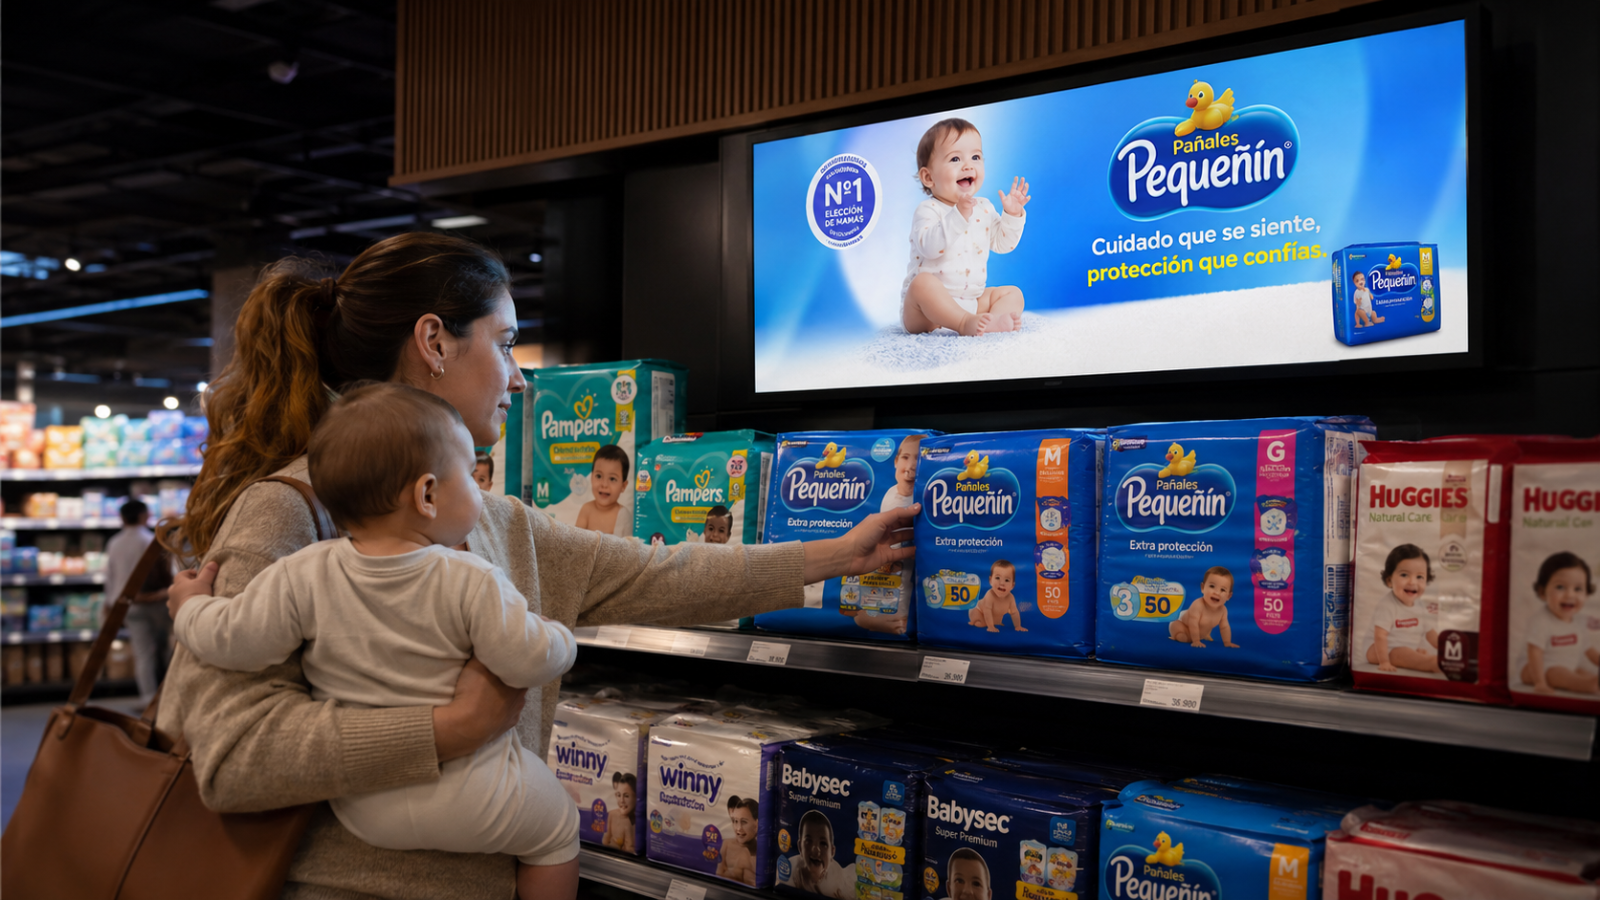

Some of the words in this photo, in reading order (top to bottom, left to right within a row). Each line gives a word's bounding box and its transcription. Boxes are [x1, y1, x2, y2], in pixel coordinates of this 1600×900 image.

[1173, 132, 1240, 155] Pañales
[1117, 139, 1286, 207] Pequeñín
[825, 205, 864, 218] ELECCIÓN
[825, 219, 835, 228] DE
[1091, 231, 1173, 256] Cuidado
[1178, 229, 1217, 248] que
[1222, 225, 1245, 241] se
[1250, 214, 1321, 238] siente,
[1087, 255, 1194, 288] protección
[1198, 253, 1239, 276] que
[1242, 241, 1328, 267] confías.
[541, 410, 610, 442] Pampers
[1044, 446, 1061, 466] M
[1266, 440, 1286, 462] G
[536, 481, 550, 498] M
[665, 478, 723, 506] Pampers
[787, 467, 866, 507] Pequeñín
[1156, 479, 1198, 490] Pañales
[927, 478, 1013, 523] Pequeñín
[1122, 475, 1226, 525] Pequeñín
[787, 517, 808, 528] Extra
[809, 517, 853, 529] protección
[1369, 512, 1405, 523] Natural
[1407, 512, 1433, 523] Care
[935, 536, 956, 546] Extra
[958, 537, 1003, 549] protección
[1129, 540, 1156, 551] Extra
[1158, 540, 1213, 553] protección
[951, 586, 970, 602] 50
[1044, 586, 1061, 599] 50
[1145, 596, 1171, 614] 50
[1263, 598, 1284, 612] 50
[556, 741, 607, 778] winny
[659, 762, 722, 803] winny
[782, 763, 850, 797] Babysec
[788, 790, 808, 803] Super
[927, 795, 1010, 833] Babysec
[935, 826, 958, 840] Super
[959, 831, 998, 848] Premium
[1143, 864, 1185, 882] Pañales
[1278, 856, 1299, 878] M
